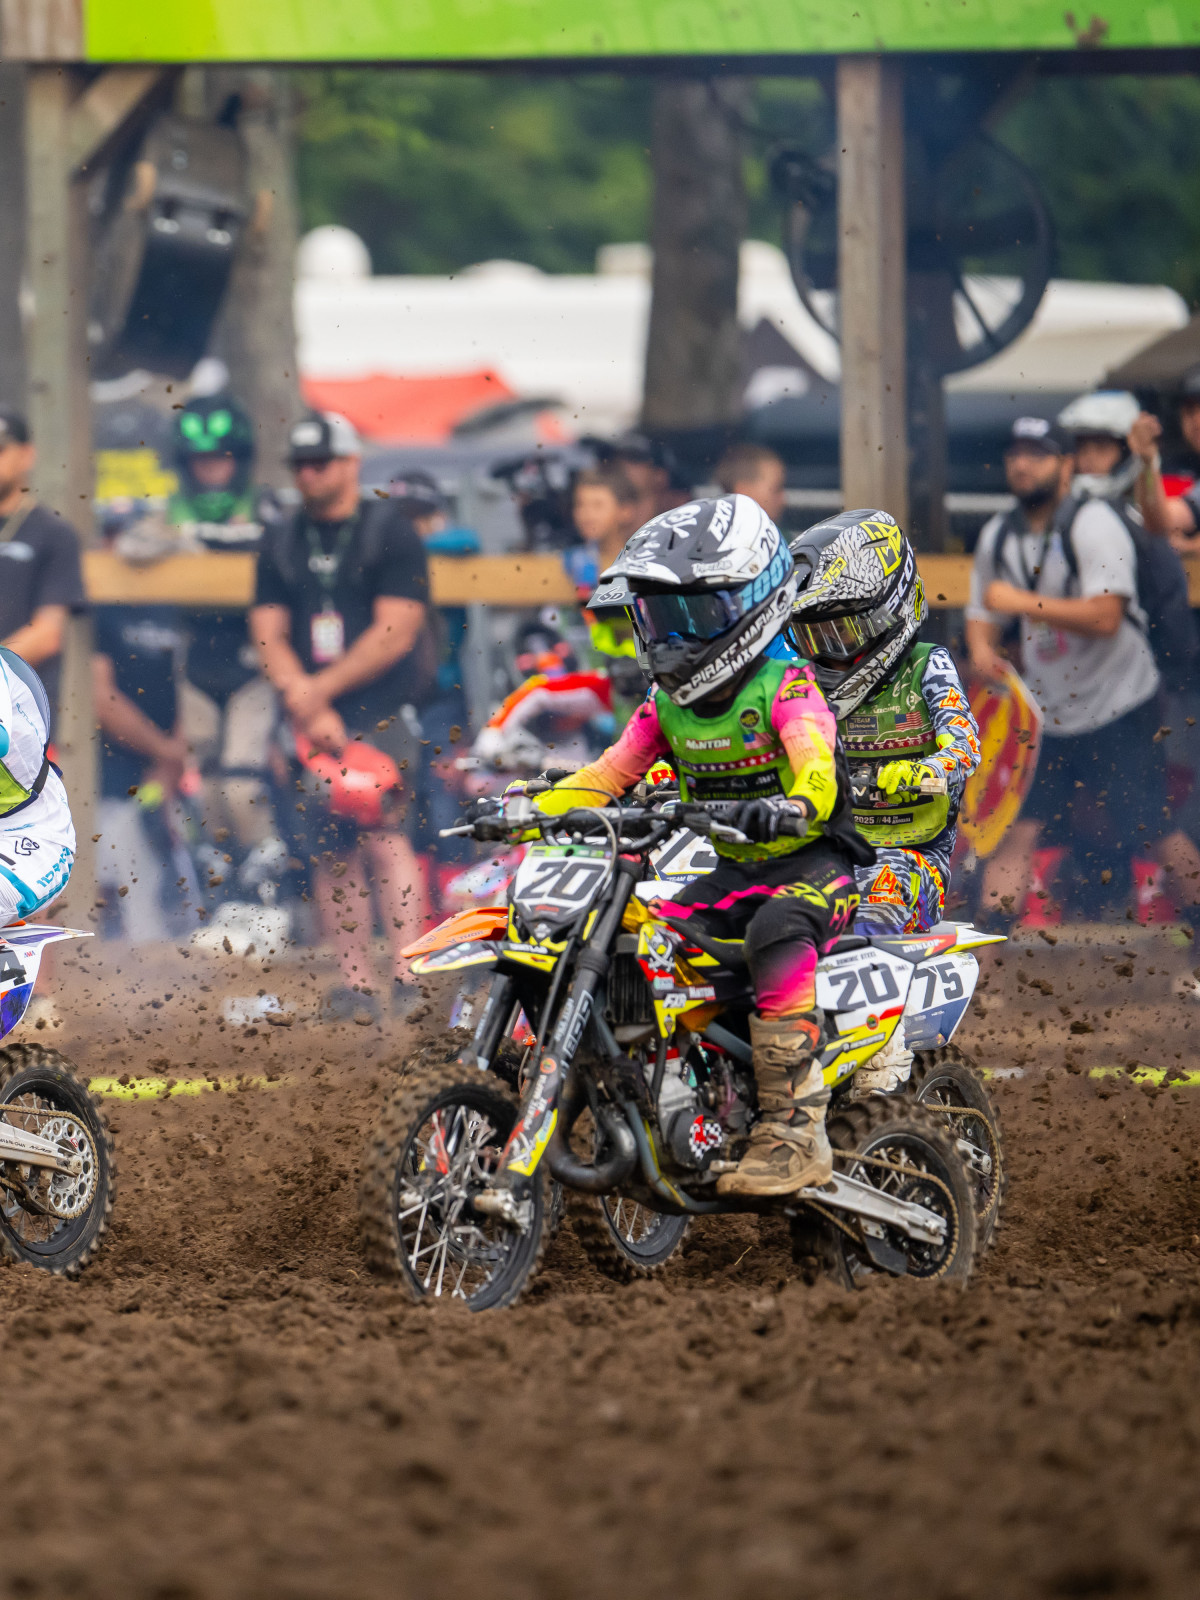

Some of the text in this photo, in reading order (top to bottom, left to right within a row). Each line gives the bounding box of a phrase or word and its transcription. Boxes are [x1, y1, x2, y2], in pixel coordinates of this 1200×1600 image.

[854, 815, 875, 825] 2025
[517, 861, 606, 901] 20
[903, 939, 940, 953] DUNLOP
[828, 962, 900, 1010] 20
[914, 961, 964, 1009] 75
